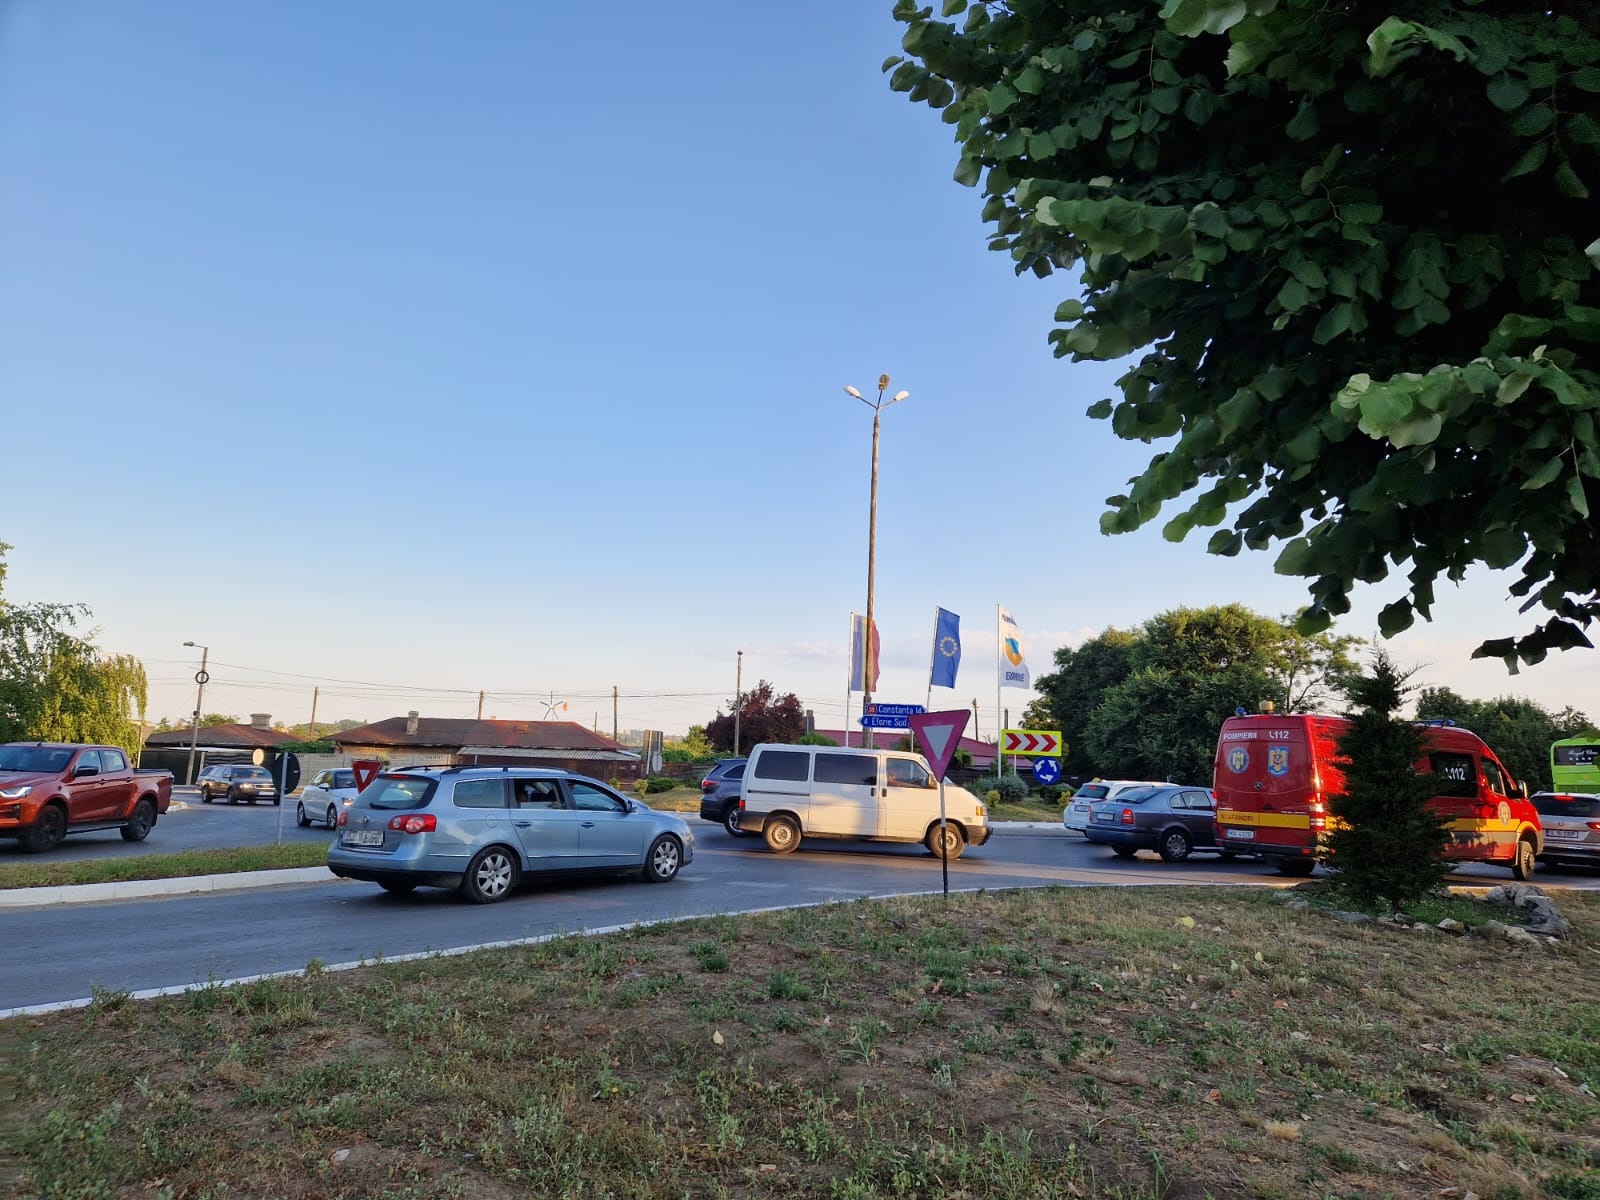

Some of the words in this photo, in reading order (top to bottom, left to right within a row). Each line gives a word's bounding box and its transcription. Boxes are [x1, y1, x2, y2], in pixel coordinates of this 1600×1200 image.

[871, 717, 892, 726] Eforie
[894, 717, 908, 727] Sud
[1223, 732, 1257, 740] POMPIERII
[1274, 730, 1289, 739] 112
[1450, 767, 1466, 781] 112
